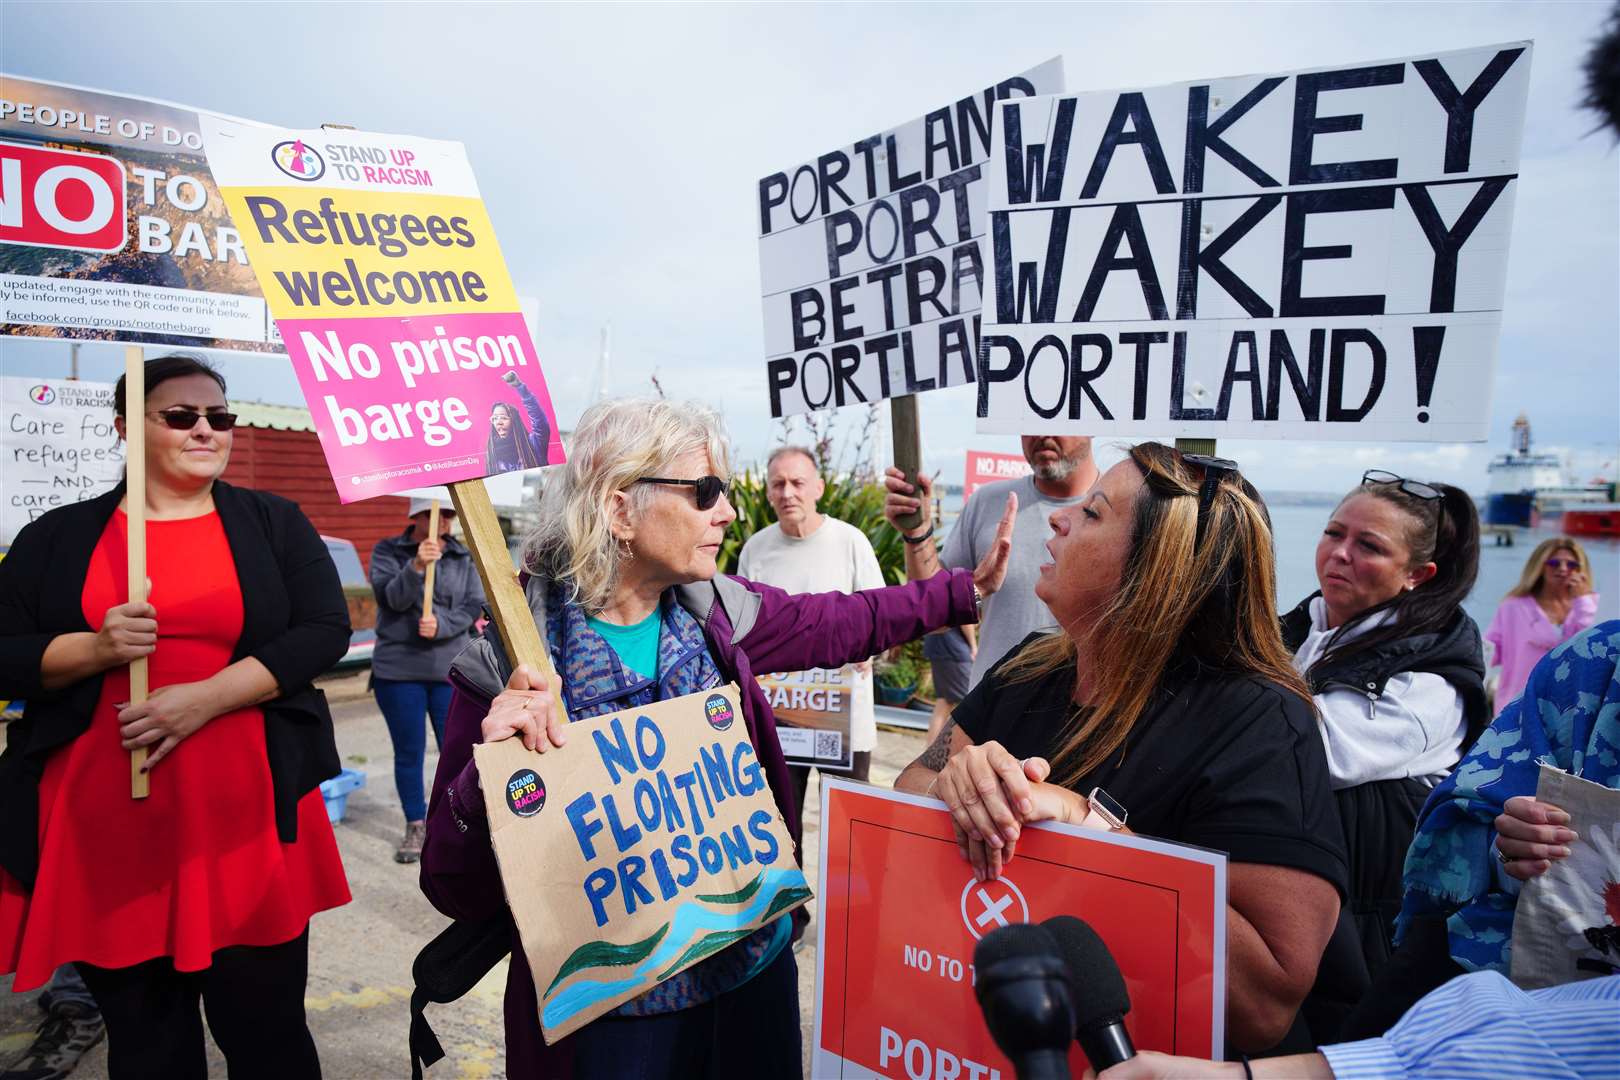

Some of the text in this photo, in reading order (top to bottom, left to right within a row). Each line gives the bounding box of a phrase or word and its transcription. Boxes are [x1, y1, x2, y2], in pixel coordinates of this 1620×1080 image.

[0, 99, 203, 150] PEOPLE OF DO
[1002, 48, 1526, 204] WAKEY
[325, 144, 415, 166] STAND UP
[332, 163, 433, 186] TO RACISM
[133, 168, 207, 212] TO
[138, 215, 249, 266] BAR
[244, 196, 476, 258] Refugees
[825, 165, 982, 280] PORT
[992, 174, 1518, 325] WAKEY
[4, 280, 239, 308] updated, engage with the community, and
[14, 290, 29, 301] be
[32, 292, 88, 306] informed,
[90, 299, 110, 307] use
[112, 298, 131, 308] the
[133, 300, 151, 310] QR
[153, 303, 180, 313] code
[196, 303, 215, 316] link
[272, 258, 489, 307] welcome
[790, 240, 984, 351] BETRA
[6, 309, 211, 335] facebook.com/groups/notothebarge
[300, 326, 528, 388] No prison
[977, 328, 1388, 422] PORTLAND
[58, 387, 110, 399] STAND UP
[60, 397, 73, 408] TO
[10, 413, 115, 441] Care for
[324, 395, 473, 447] barge
[14, 444, 124, 474] refugees
[11, 494, 63, 507] care
[53, 475, 95, 488] AND
[707, 698, 725, 709] STAND
[591, 715, 666, 785] NO
[509, 773, 535, 792] STAND
[512, 783, 537, 801] UP TO
[514, 788, 545, 809] RACISM
[565, 741, 767, 862] FLOATING
[583, 810, 779, 928] PRISONS
[904, 944, 932, 973] NO
[937, 954, 964, 982] TO
[880, 1025, 1001, 1080] PORT
